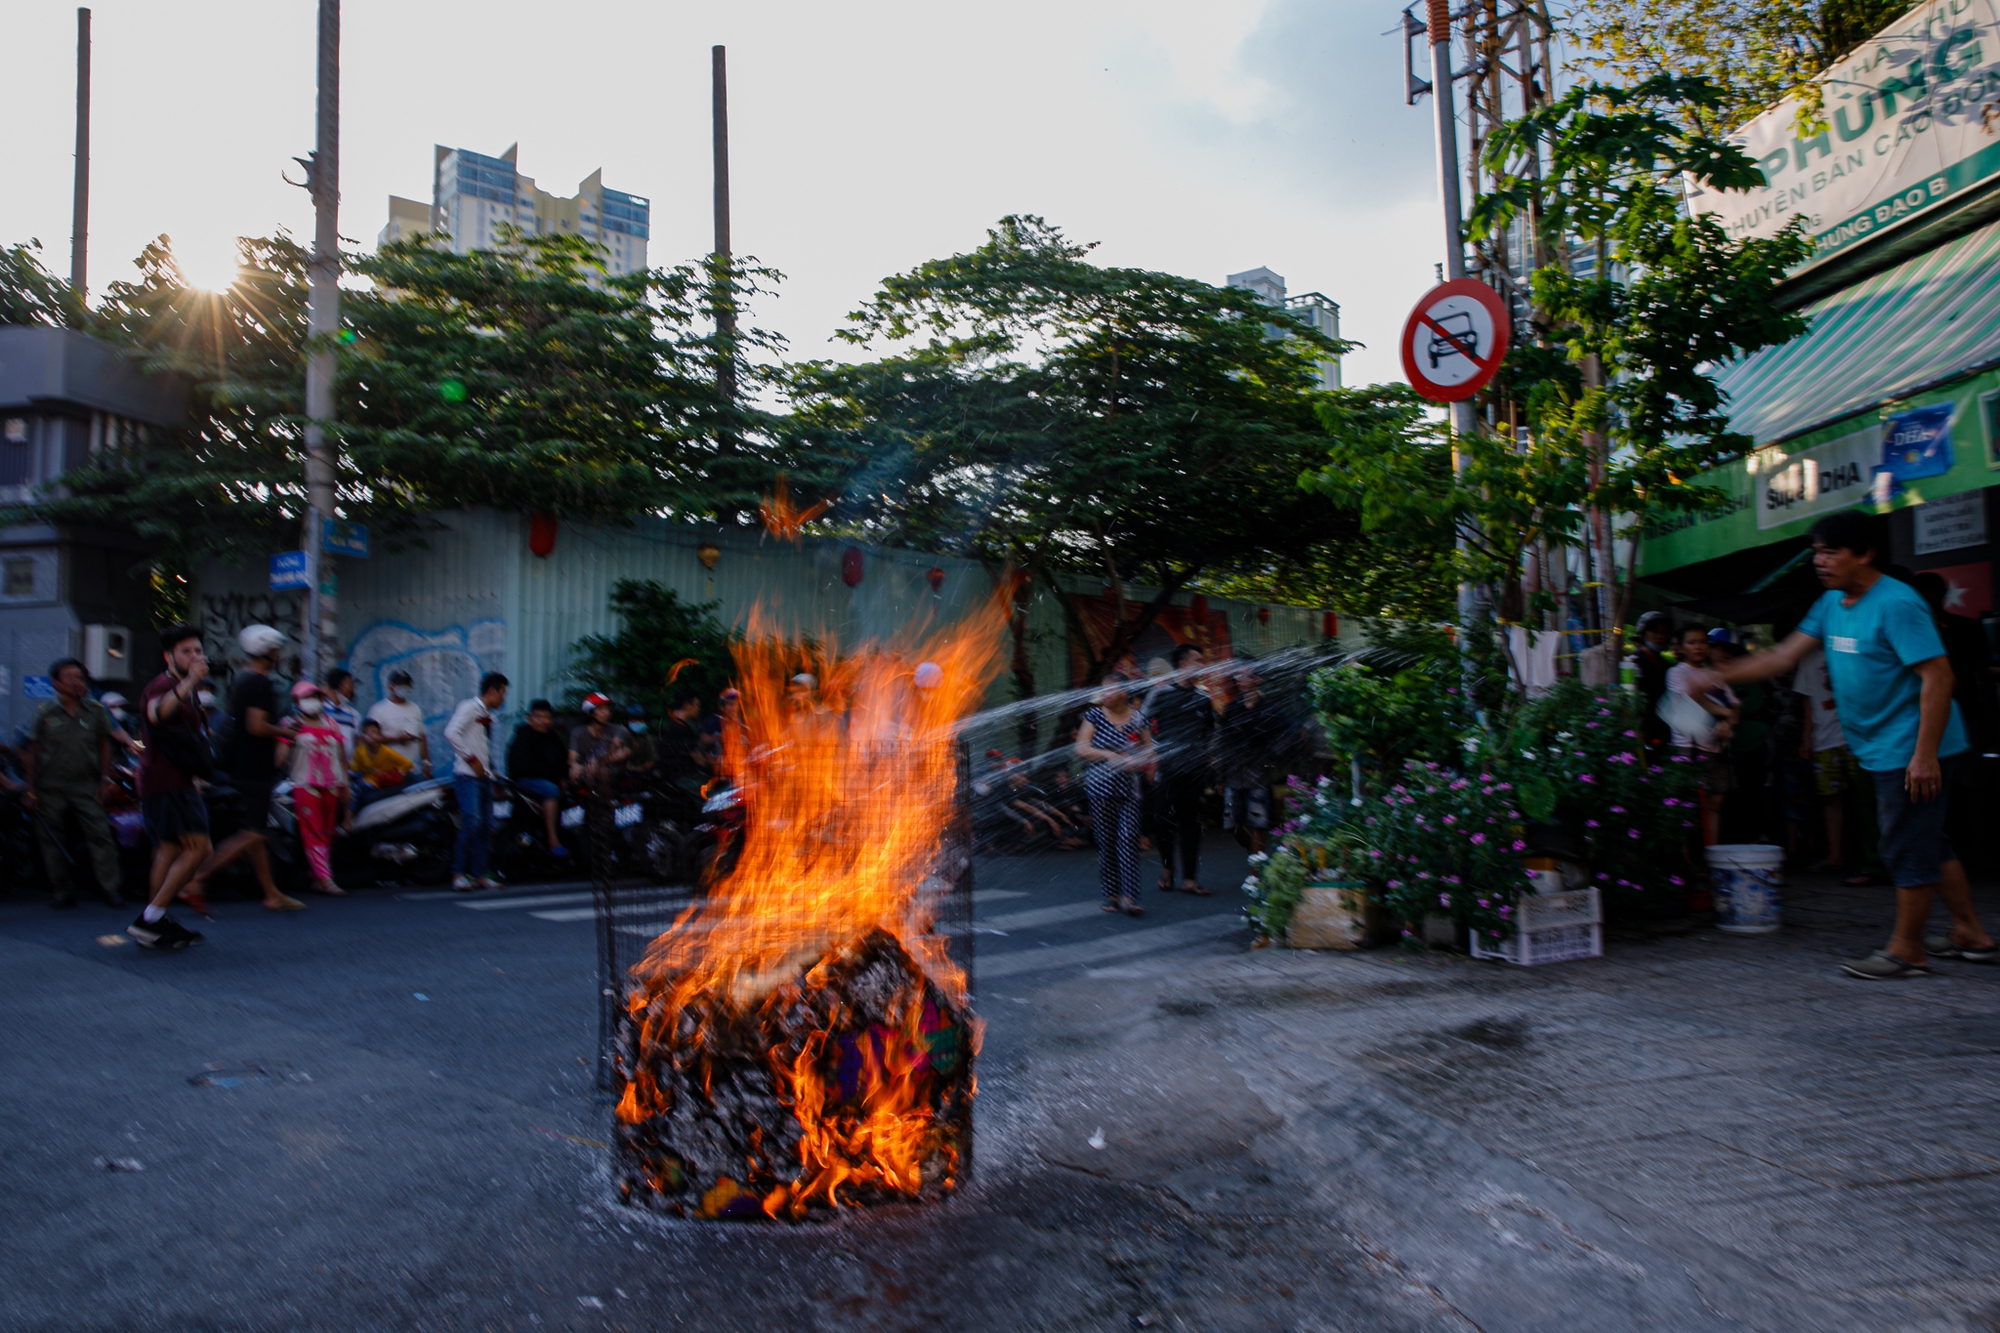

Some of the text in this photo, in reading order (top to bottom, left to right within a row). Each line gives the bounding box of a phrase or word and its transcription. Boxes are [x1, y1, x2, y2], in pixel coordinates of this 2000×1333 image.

[1831, 44, 1893, 95] NHÀ
[1760, 28, 1984, 193] PHÙNG
[1812, 148, 1864, 193] BÁN
[1875, 109, 1931, 156] CAO
[1874, 188, 1926, 223] ĐẠO
[1928, 177, 1948, 197] B
[1819, 461, 1860, 493] DHA
